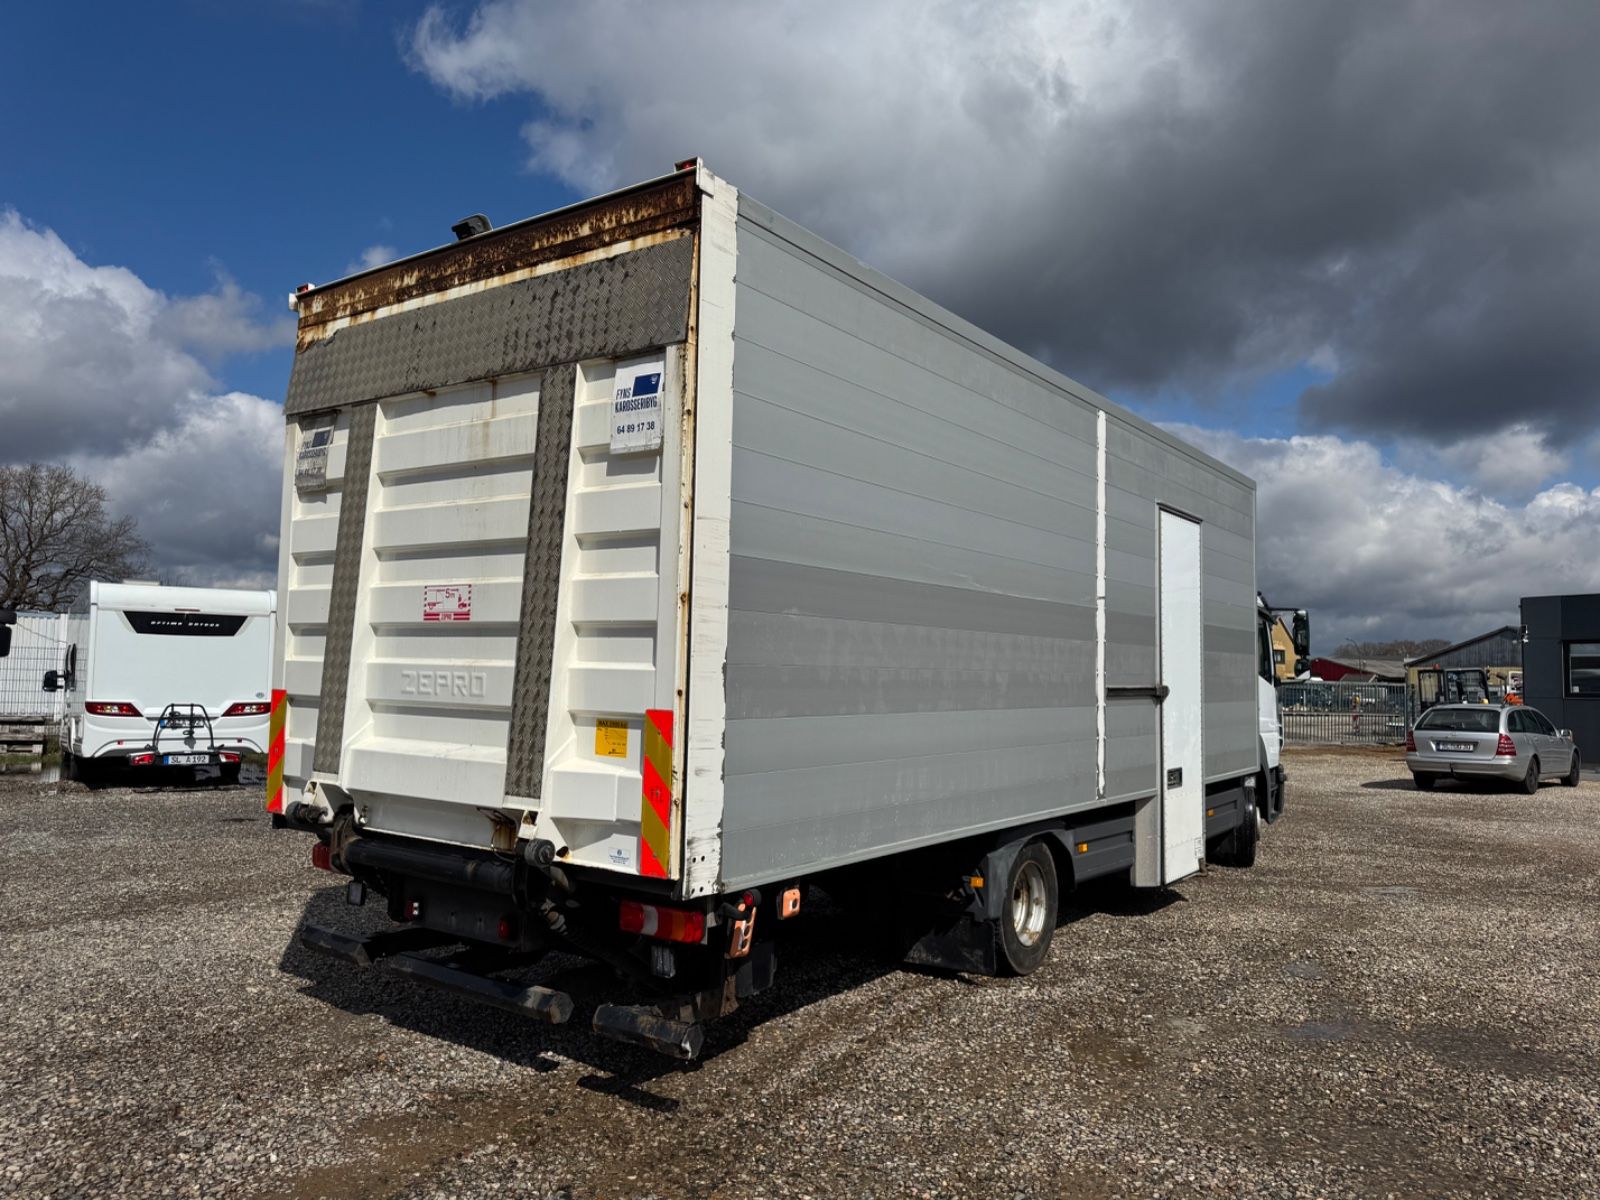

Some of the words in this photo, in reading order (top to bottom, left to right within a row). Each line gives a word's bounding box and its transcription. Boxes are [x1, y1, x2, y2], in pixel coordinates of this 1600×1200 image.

[616, 387, 632, 400] FYNS
[616, 425, 625, 434] 64
[627, 424, 635, 433] 89
[637, 422, 645, 432] 17
[646, 421, 655, 431] 38
[400, 670, 487, 698] ZEPRO
